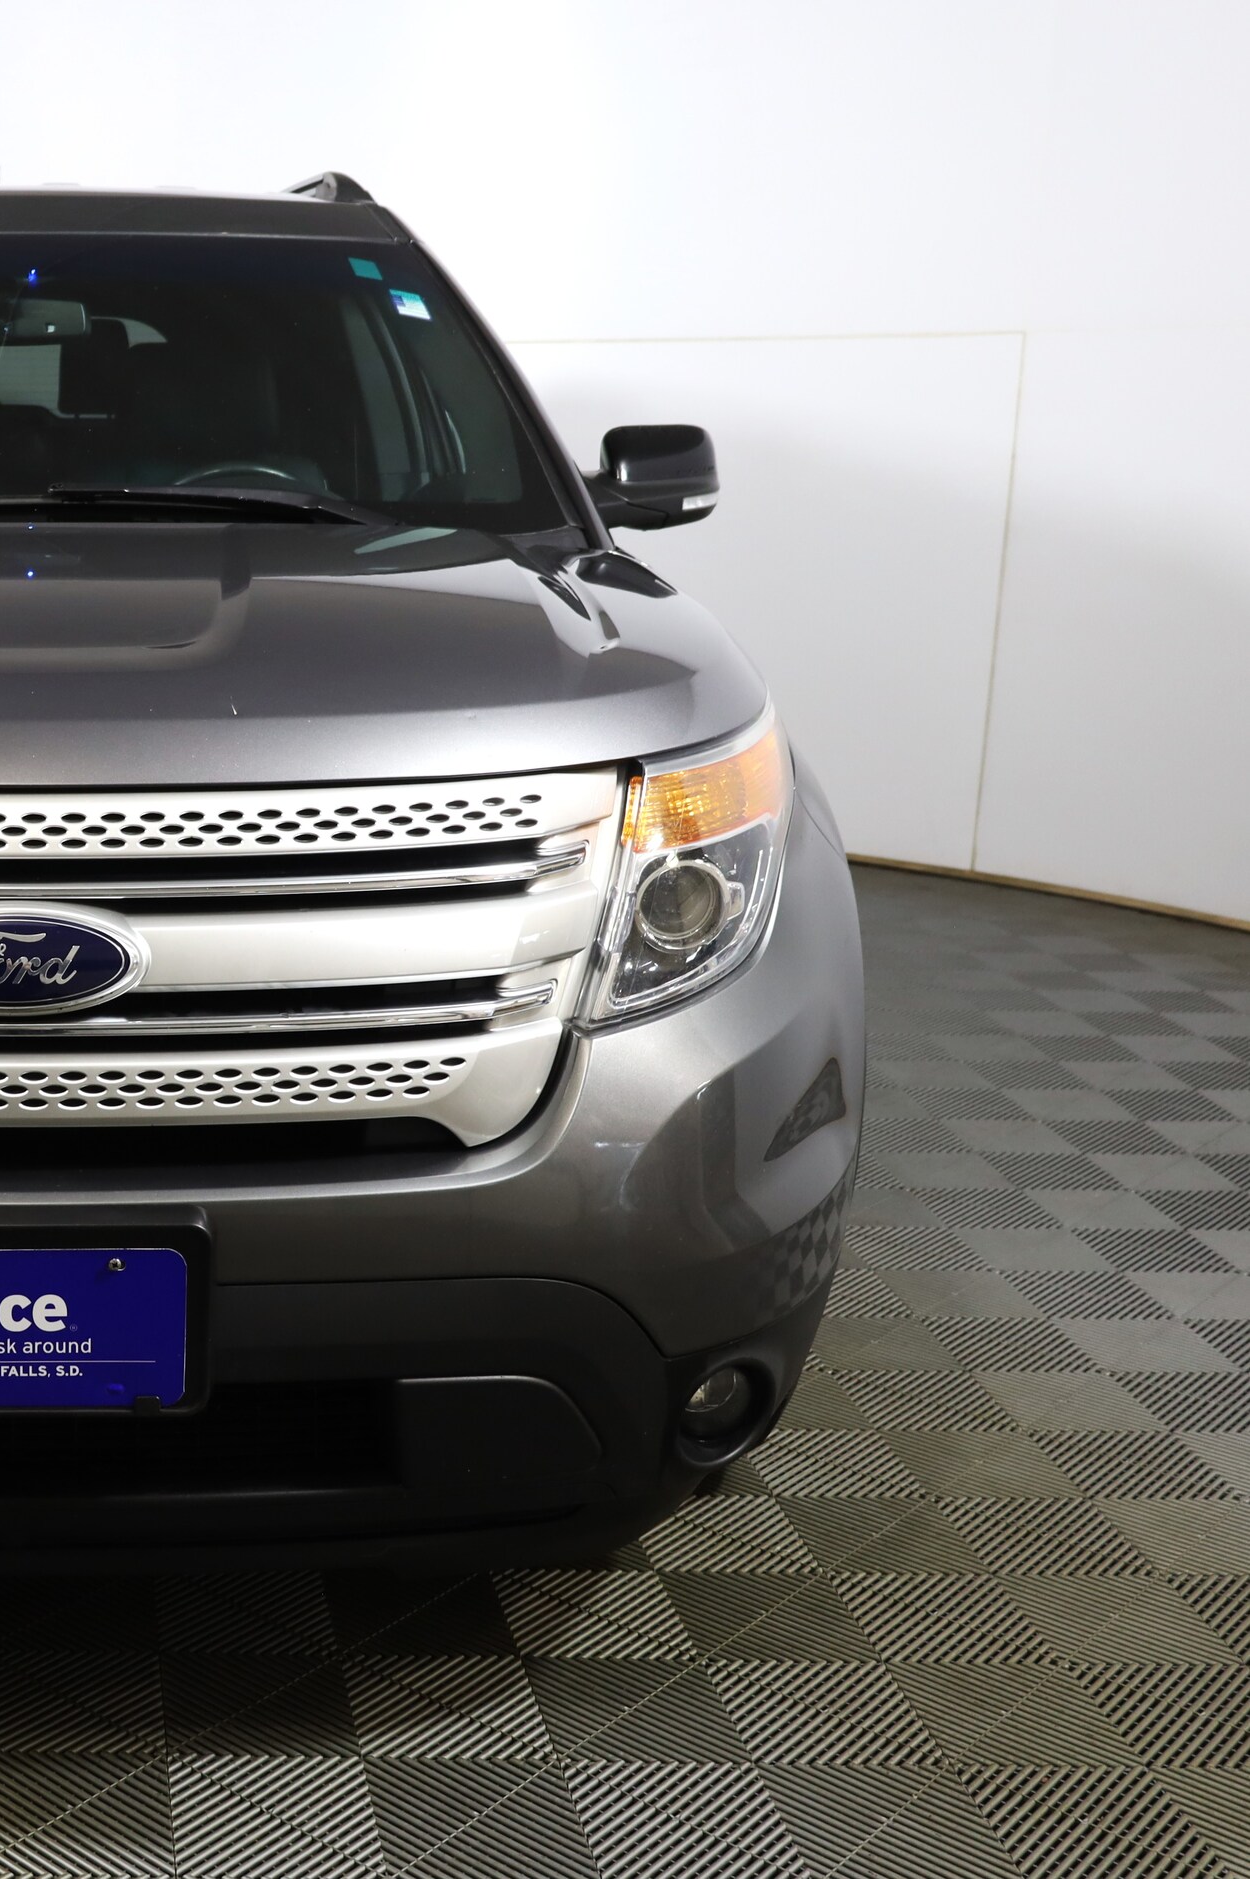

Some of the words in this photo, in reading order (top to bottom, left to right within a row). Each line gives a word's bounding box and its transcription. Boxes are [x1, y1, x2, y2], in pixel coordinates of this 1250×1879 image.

[22, 1338, 92, 1354] around
[0, 1365, 51, 1379] FALLS,
[56, 1365, 83, 1378] S.D.
